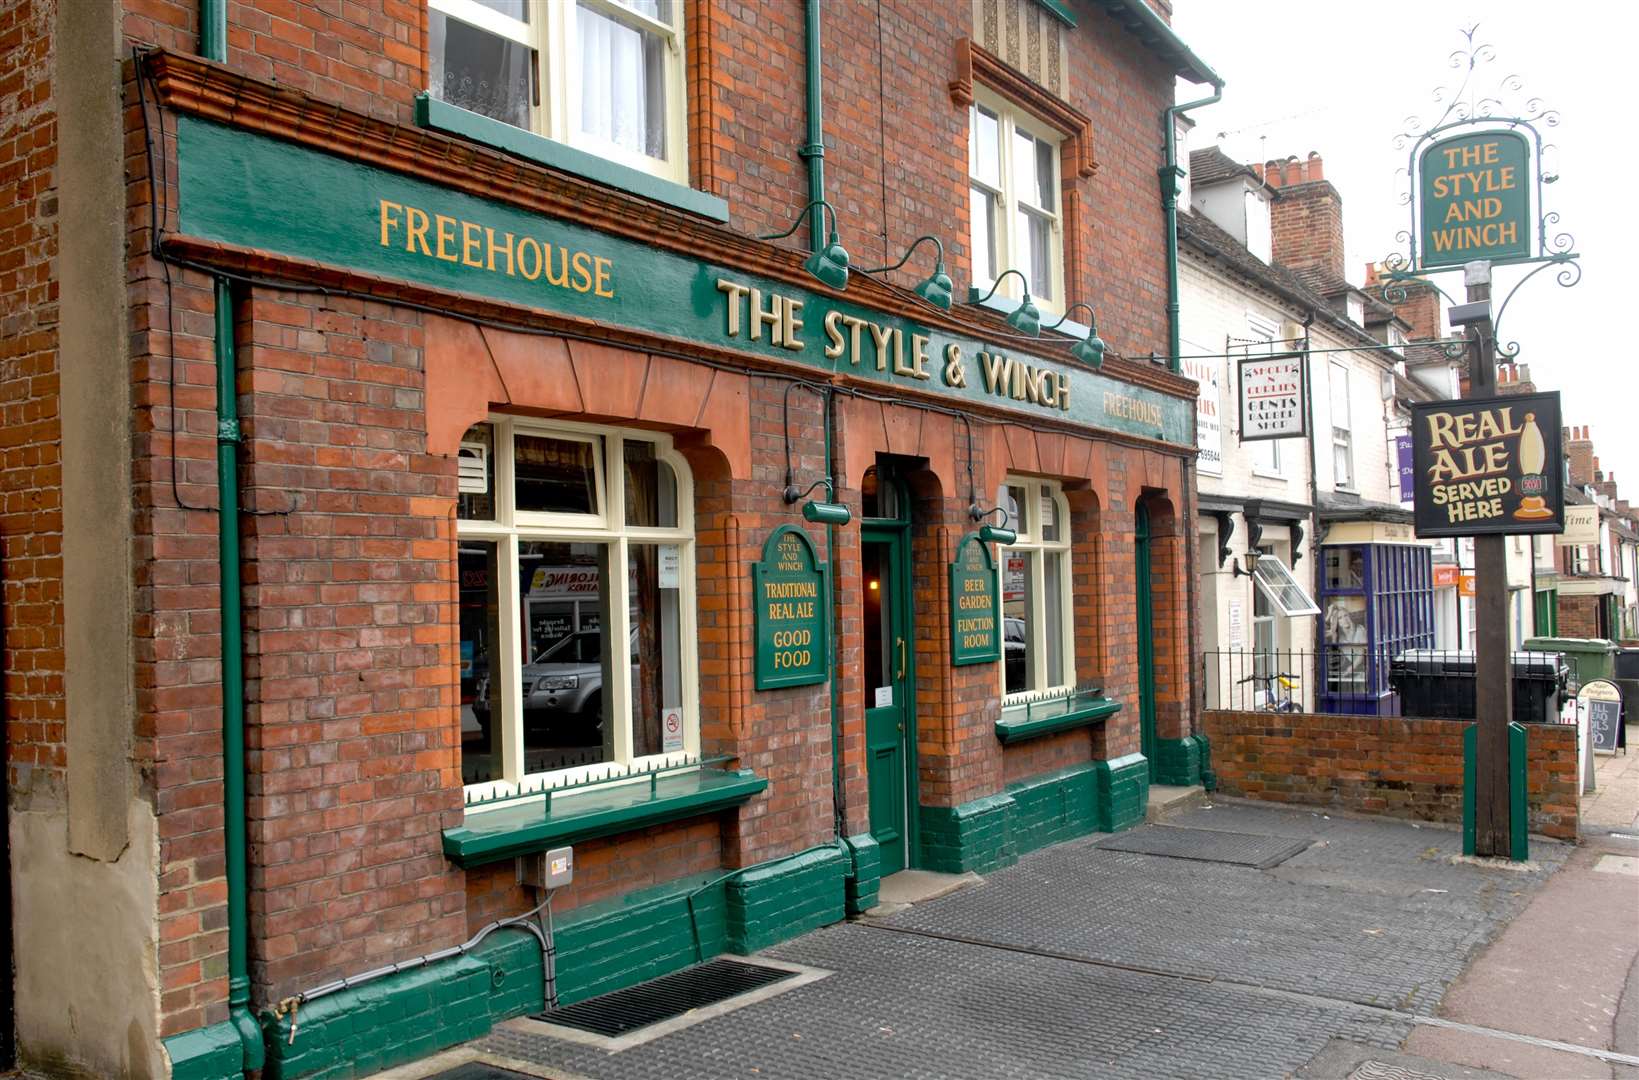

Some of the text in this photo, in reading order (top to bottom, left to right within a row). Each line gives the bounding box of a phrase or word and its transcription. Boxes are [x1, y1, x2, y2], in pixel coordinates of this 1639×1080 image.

[1443, 142, 1500, 169] THE
[1433, 166, 1516, 198] STYLE
[1444, 197, 1503, 224] AND
[1432, 221, 1518, 252] WINCH
[379, 199, 614, 298] FREEHOUSE
[717, 278, 1071, 412] THE STYLE & WINCH
[1252, 365, 1290, 376] SHORT
[1247, 384, 1297, 395] CURLIES
[1103, 391, 1163, 428] FREEHOUSE
[1248, 398, 1297, 411] GENTS
[1248, 410, 1296, 421] BARBER
[1257, 421, 1287, 430] SHOP
[1425, 407, 1523, 448] REAL
[1427, 442, 1510, 482] ALE
[1432, 477, 1512, 505] SERVED
[1447, 498, 1505, 523] HERE
[783, 534, 796, 542] THE
[777, 543, 801, 552] STYLE
[782, 552, 797, 561] AND
[777, 561, 803, 571] WINCH
[765, 582, 817, 598] TRADITIONAL
[964, 579, 985, 592] BEER
[959, 594, 992, 609] GARDEN
[769, 602, 814, 620] REAL ALE
[958, 617, 994, 633] FUNCTION
[773, 629, 811, 648] GOOD
[964, 636, 989, 649] ROOM
[774, 650, 811, 668] FOOD
